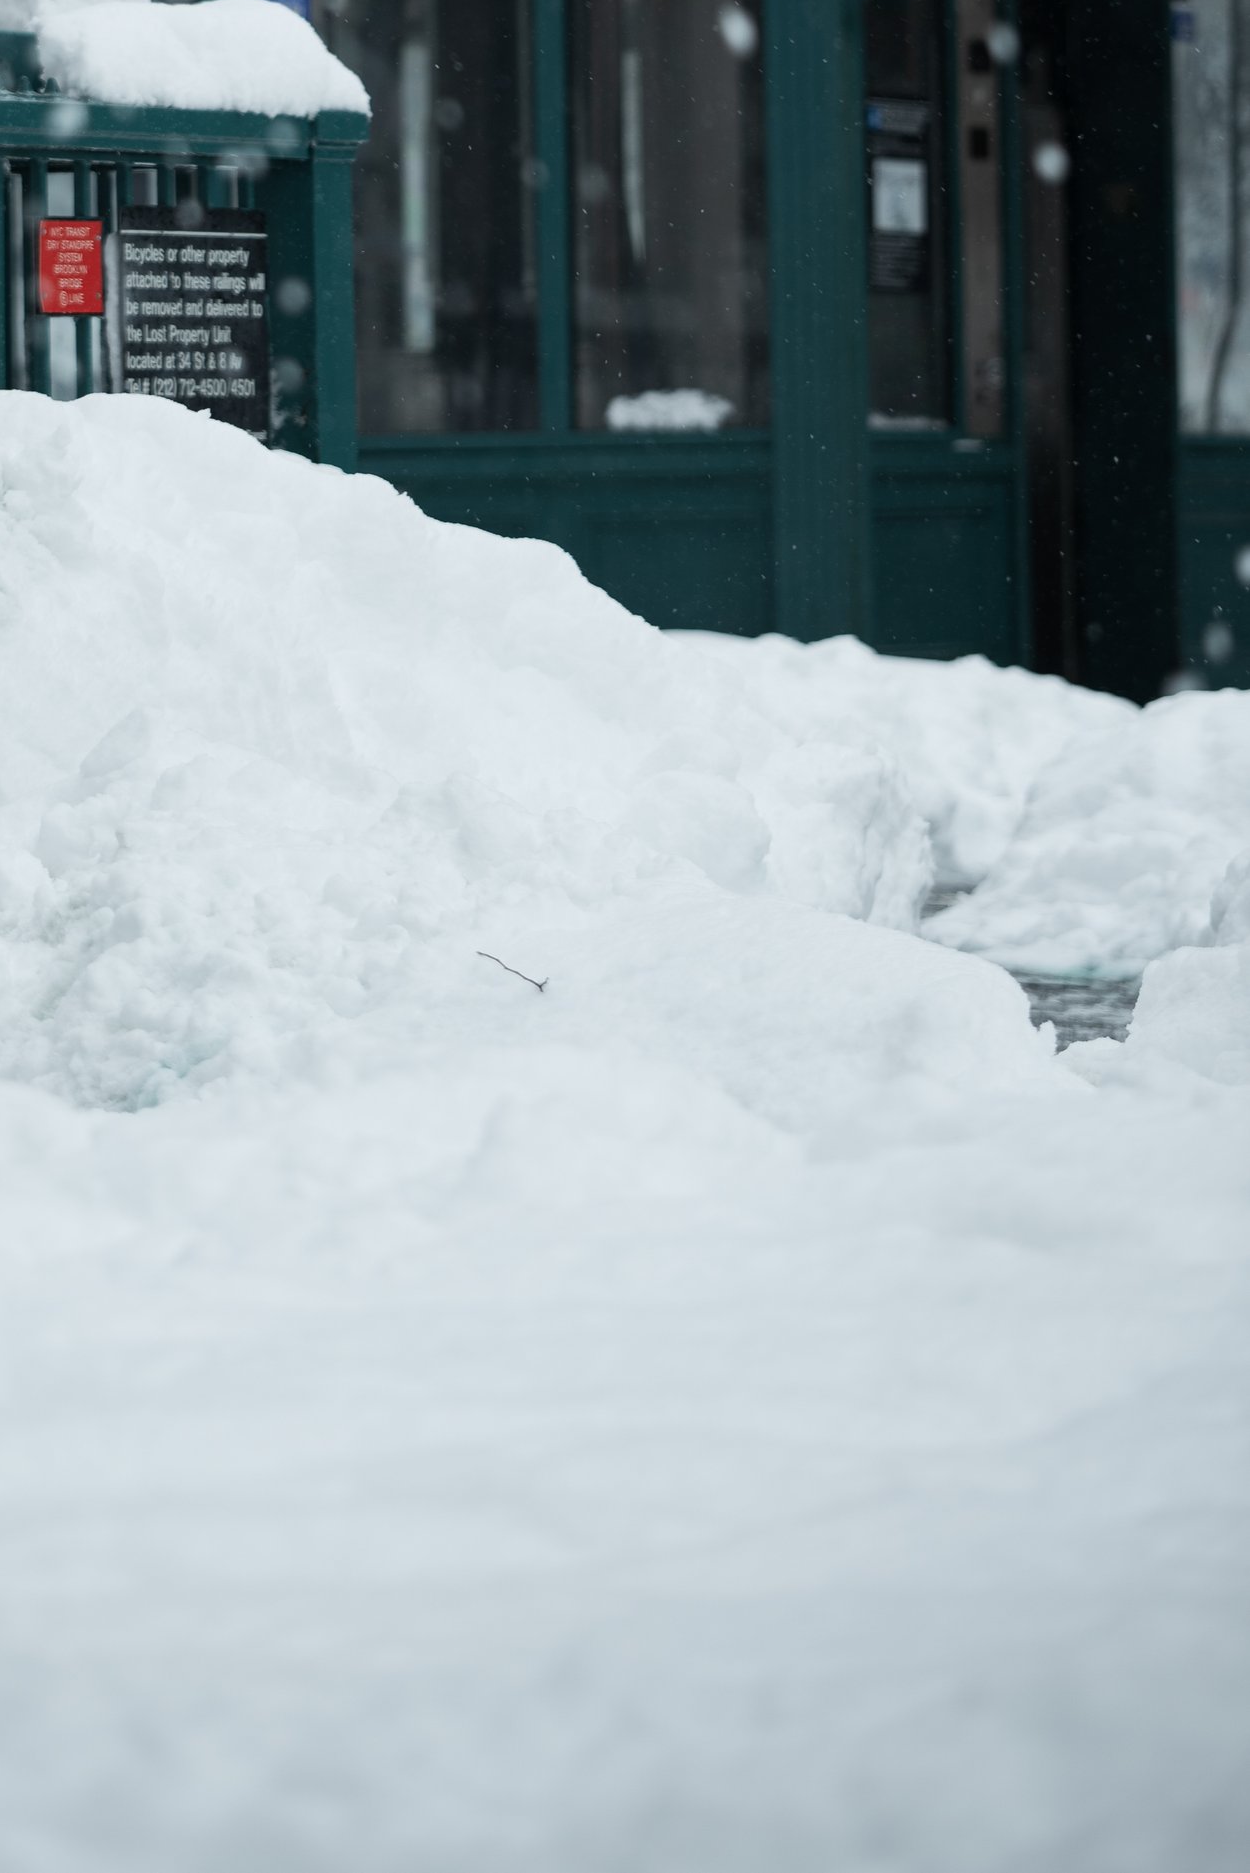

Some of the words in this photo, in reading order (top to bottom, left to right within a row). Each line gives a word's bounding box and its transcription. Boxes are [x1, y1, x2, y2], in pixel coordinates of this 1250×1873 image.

[125, 243, 164, 264] Bicycles
[167, 249, 177, 262] or
[180, 245, 205, 262] other
[208, 247, 249, 267] property
[126, 271, 168, 289] attached
[170, 272, 181, 289] to
[183, 272, 211, 289] these
[212, 273, 246, 294] railings
[248, 273, 265, 290] will
[126, 297, 139, 315] be
[141, 299, 182, 315] removed
[185, 299, 203, 316] and
[206, 299, 249, 316] delivered
[251, 300, 263, 316] to
[127, 325, 142, 342] the
[145, 325, 167, 342] Lost
[169, 325, 210, 346] Property
[212, 326, 232, 343] Unit
[127, 352, 162, 369] located
[165, 353, 175, 369] at
[178, 352, 191, 369] 34
[194, 352, 205, 369] St
[208, 353, 216, 369] &
[219, 352, 227, 369] 8
[153, 377, 177, 396] (212)
